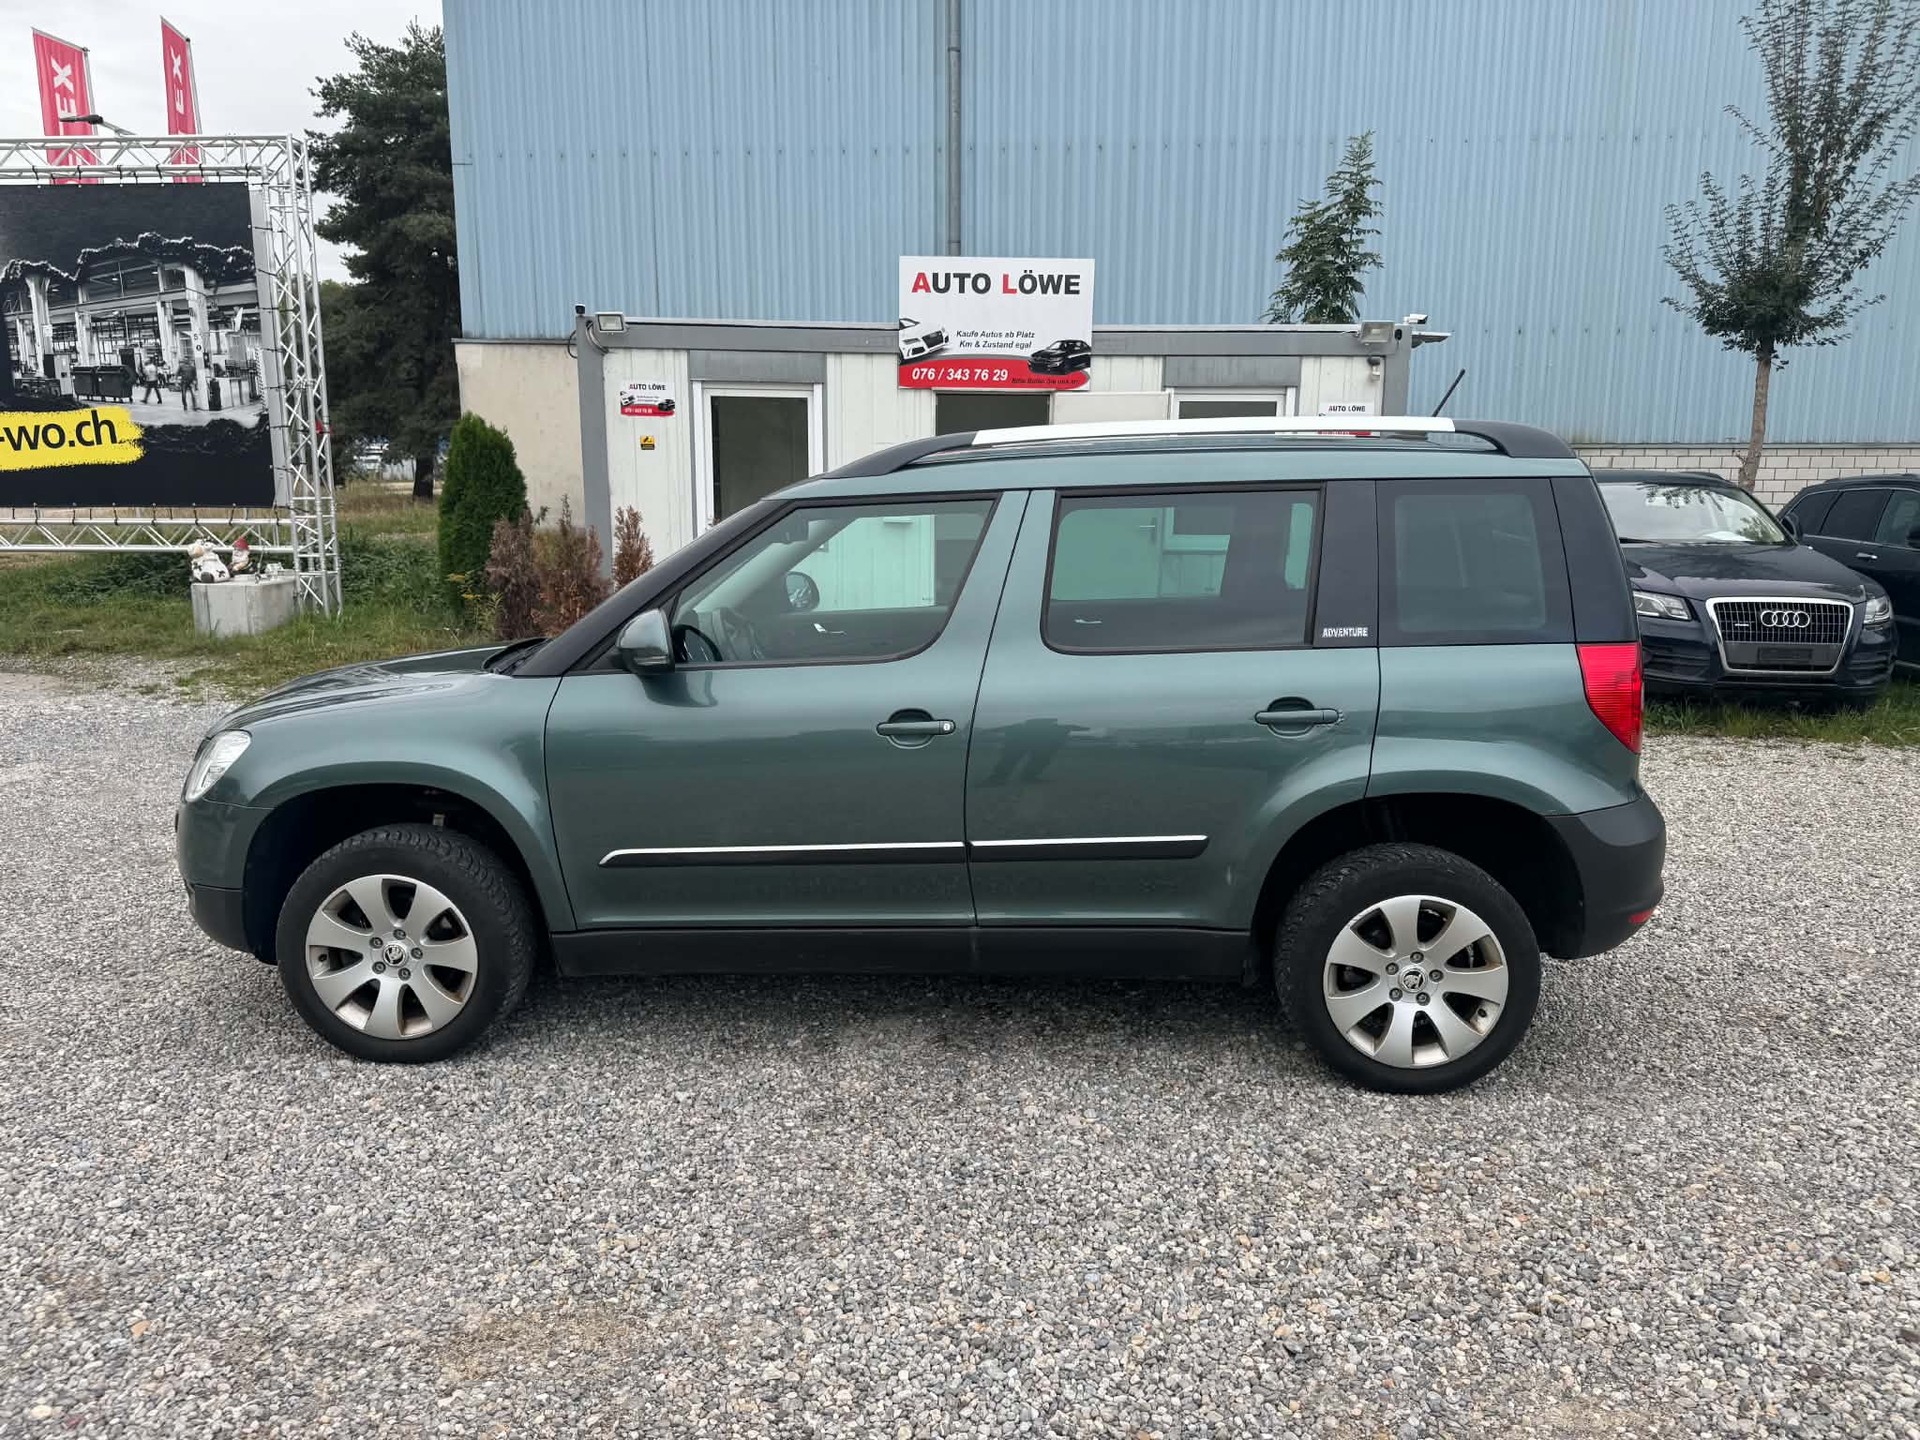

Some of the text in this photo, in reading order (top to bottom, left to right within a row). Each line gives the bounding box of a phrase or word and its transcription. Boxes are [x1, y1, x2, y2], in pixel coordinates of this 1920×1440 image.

[911, 269, 1081, 295] AUTO LÖWE
[956, 330, 979, 338] Kaufe
[980, 330, 1002, 338] Autos
[959, 340, 1032, 350] Km & Zustand egal
[911, 367, 1008, 381] 076 / 343 76 29
[629, 383, 667, 391] AUTO LÖWE
[1321, 626, 1369, 638] ADVENTURE
